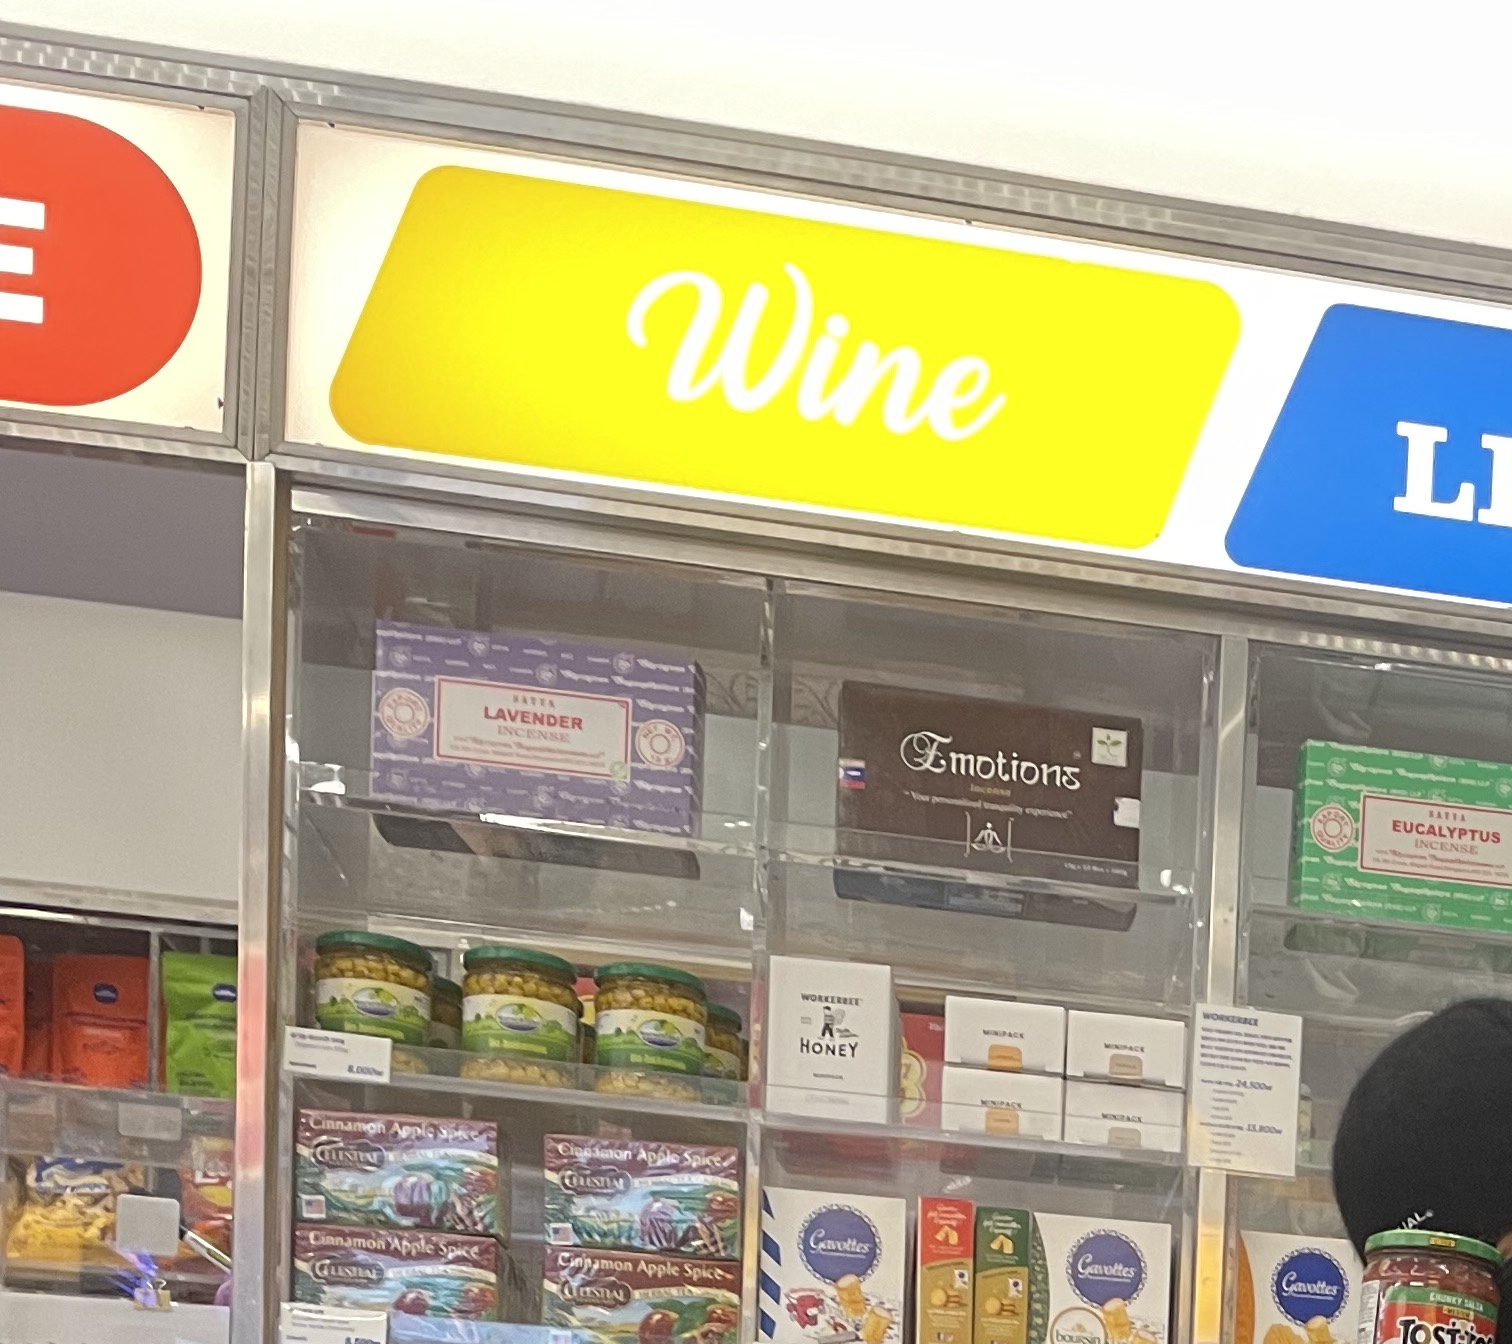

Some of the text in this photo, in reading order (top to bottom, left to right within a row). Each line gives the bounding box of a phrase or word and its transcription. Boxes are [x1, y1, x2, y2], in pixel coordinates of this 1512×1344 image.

[626, 262, 1006, 441] Wine
[484, 706, 583, 730] LAVENDER
[497, 725, 571, 744] INCENSE
[900, 731, 1082, 790] Emotions
[1392, 819, 1501, 844] EUCALYPTUS
[1414, 837, 1479, 856] INCENSE
[801, 992, 864, 1006] WORKERBEE
[983, 1028, 1025, 1040] MINIPACK
[800, 1037, 859, 1059] HONEY
[1104, 1042, 1146, 1053] MINIPACK
[309, 1117, 480, 1144] Cinnamon Apple Spice
[558, 1142, 725, 1170] Cinnamon Apple Spice
[309, 1230, 480, 1261] Cinnamon Apple Spice
[809, 1230, 871, 1254] Gavottes
[558, 1252, 725, 1282] Cinnamon Apple Spice
[1077, 1256, 1136, 1279] Gavottes
[1281, 1271, 1341, 1298] Gavottes
[1429, 1292, 1462, 1307] CHUNKY
